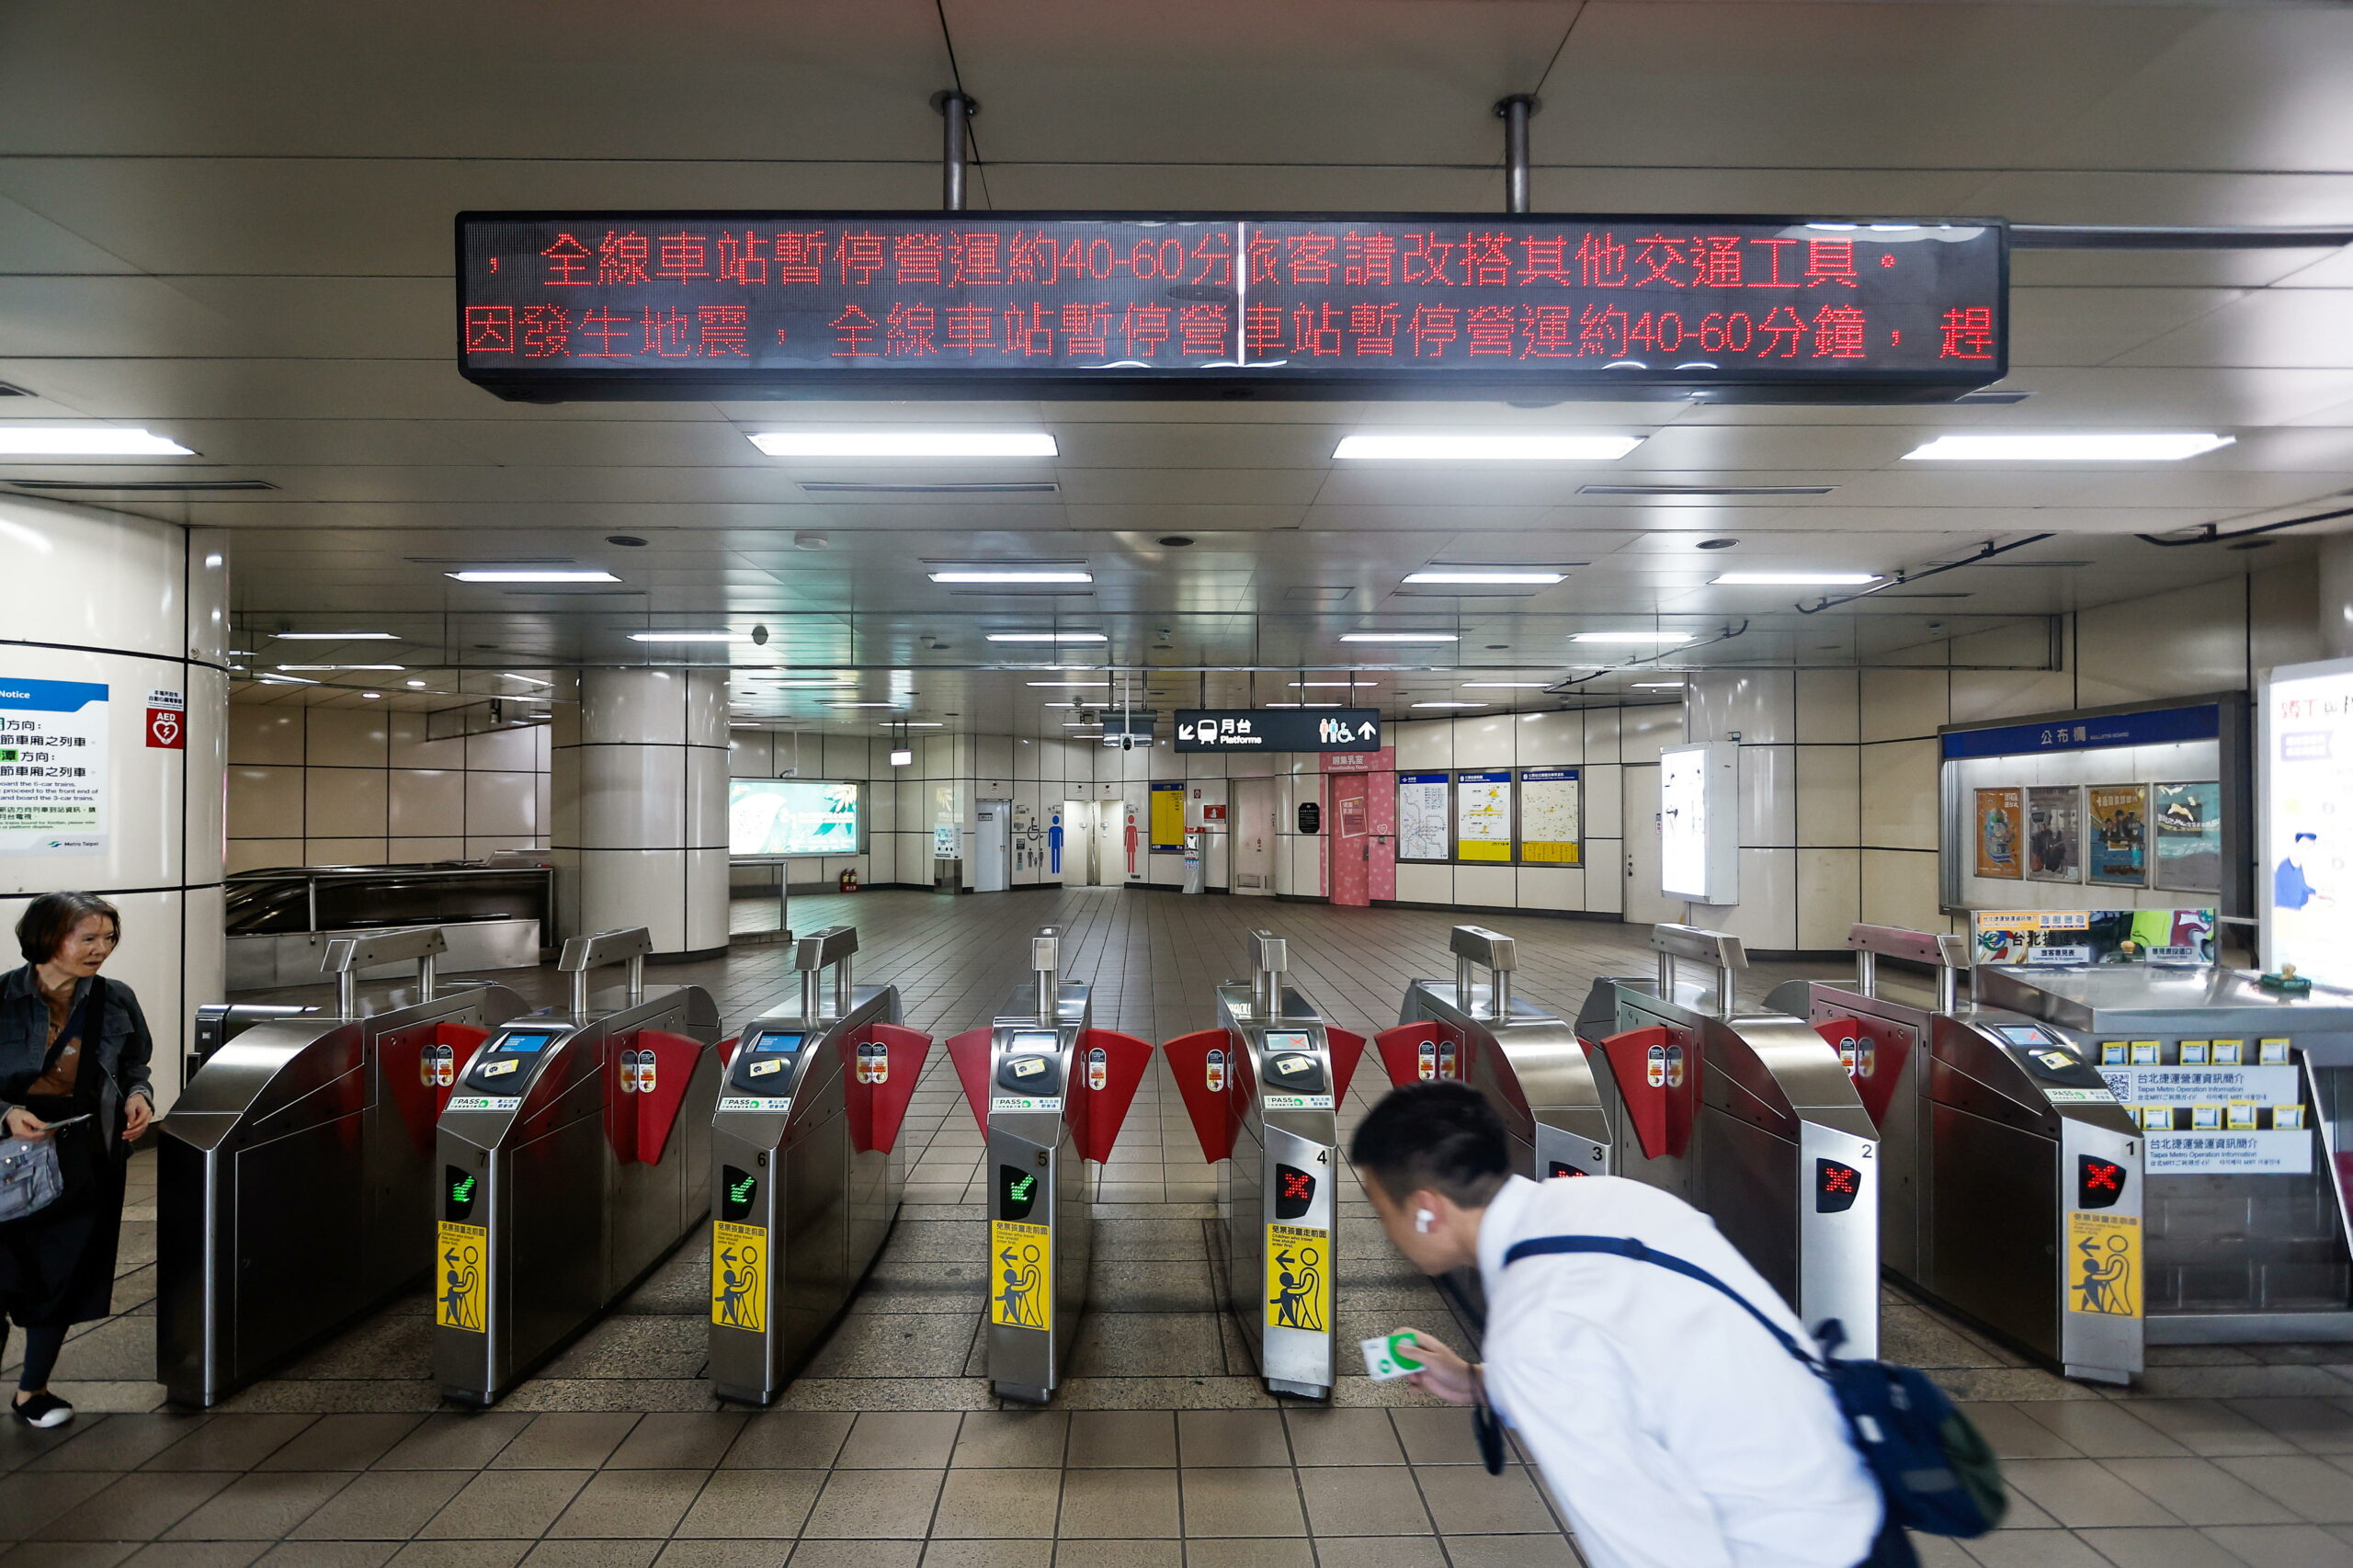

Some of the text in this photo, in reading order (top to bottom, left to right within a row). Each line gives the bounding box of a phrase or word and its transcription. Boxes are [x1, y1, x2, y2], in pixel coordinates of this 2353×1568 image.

[0, 690, 30, 699] Notice
[156, 712, 176, 722] AED
[1221, 719, 1252, 733] 月台
[1220, 735, 1262, 744] Platforms
[1592, 1146, 1603, 1162] 3
[1861, 1144, 1872, 1159] 2
[2126, 1141, 2134, 1156] 1
[478, 1152, 487, 1167] 7
[757, 1152, 767, 1167] 6
[1038, 1151, 1048, 1167] 5
[1316, 1149, 1328, 1165] 4
